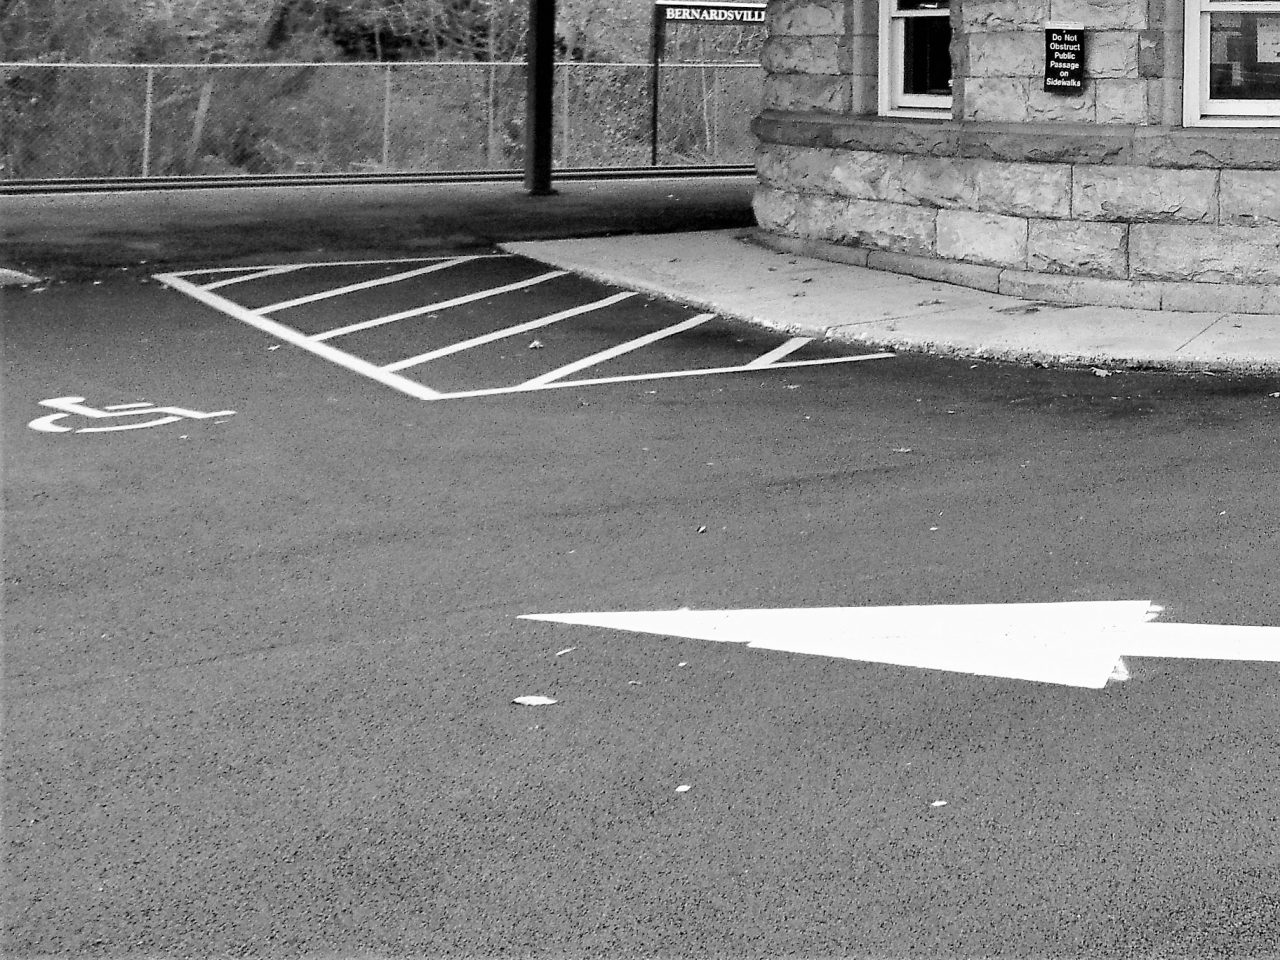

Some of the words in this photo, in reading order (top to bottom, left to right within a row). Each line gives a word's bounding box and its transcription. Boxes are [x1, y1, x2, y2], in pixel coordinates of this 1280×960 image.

[1052, 33, 1062, 41] Do
[1064, 34, 1077, 42] Not
[1049, 42, 1080, 51] Obstruct
[1054, 51, 1076, 60] Public
[1049, 60, 1080, 70] Passage
[1046, 77, 1081, 87] Sidewalks
